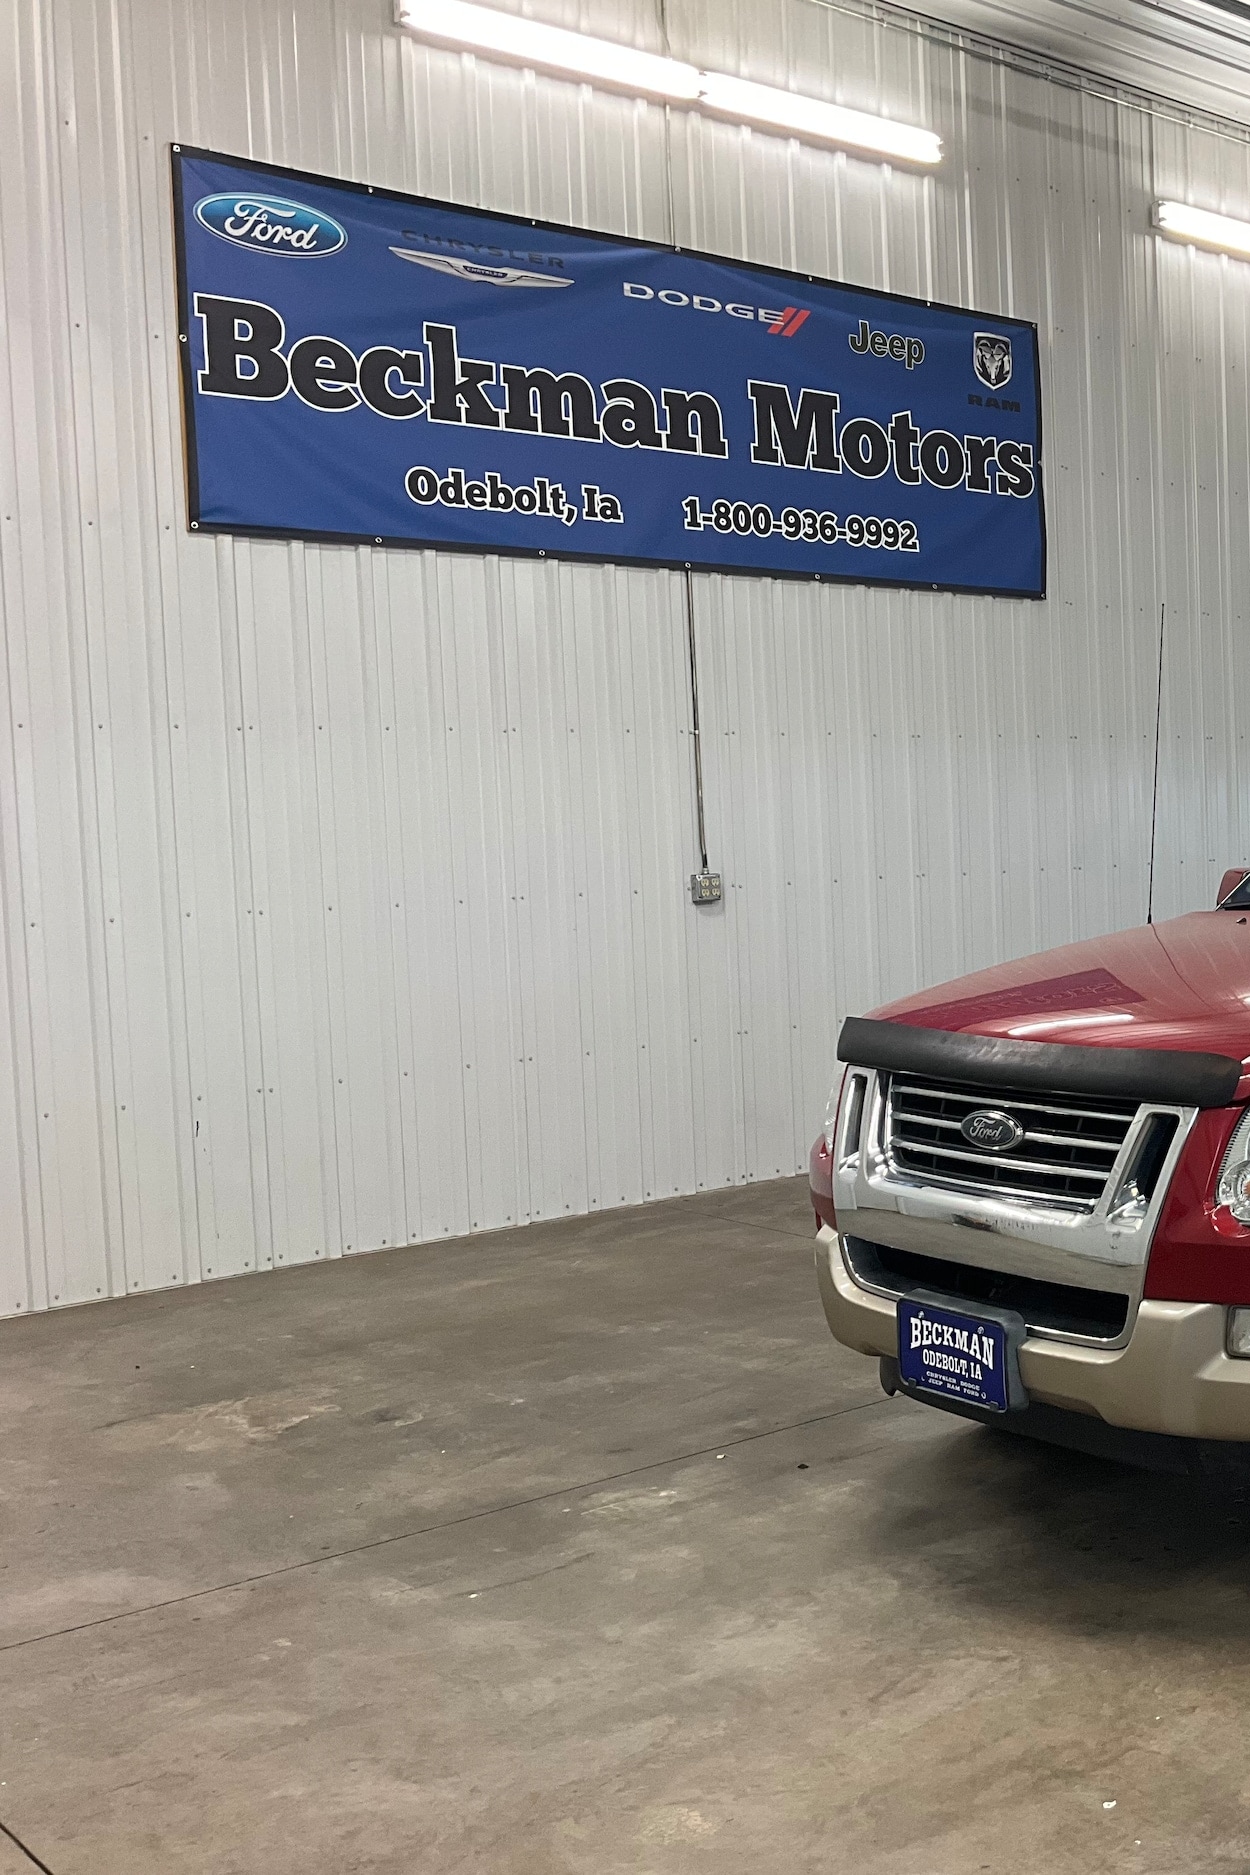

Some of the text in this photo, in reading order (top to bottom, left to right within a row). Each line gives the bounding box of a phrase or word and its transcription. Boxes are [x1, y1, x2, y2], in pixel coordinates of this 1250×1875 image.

[224, 202, 319, 251] Ford
[401, 229, 564, 269] CHRYSLER
[623, 282, 786, 325] DODGE
[849, 320, 925, 370] Jeep
[194, 292, 1036, 499] Beckman Motors
[968, 394, 1020, 412] RAM
[405, 466, 624, 525] Odebolt, Ia
[682, 497, 920, 552] 1-800-936-9992
[969, 1117, 1004, 1140] Ford
[910, 1317, 995, 1370] BECKMAN
[922, 1349, 983, 1380] ODEBOLT, IA
